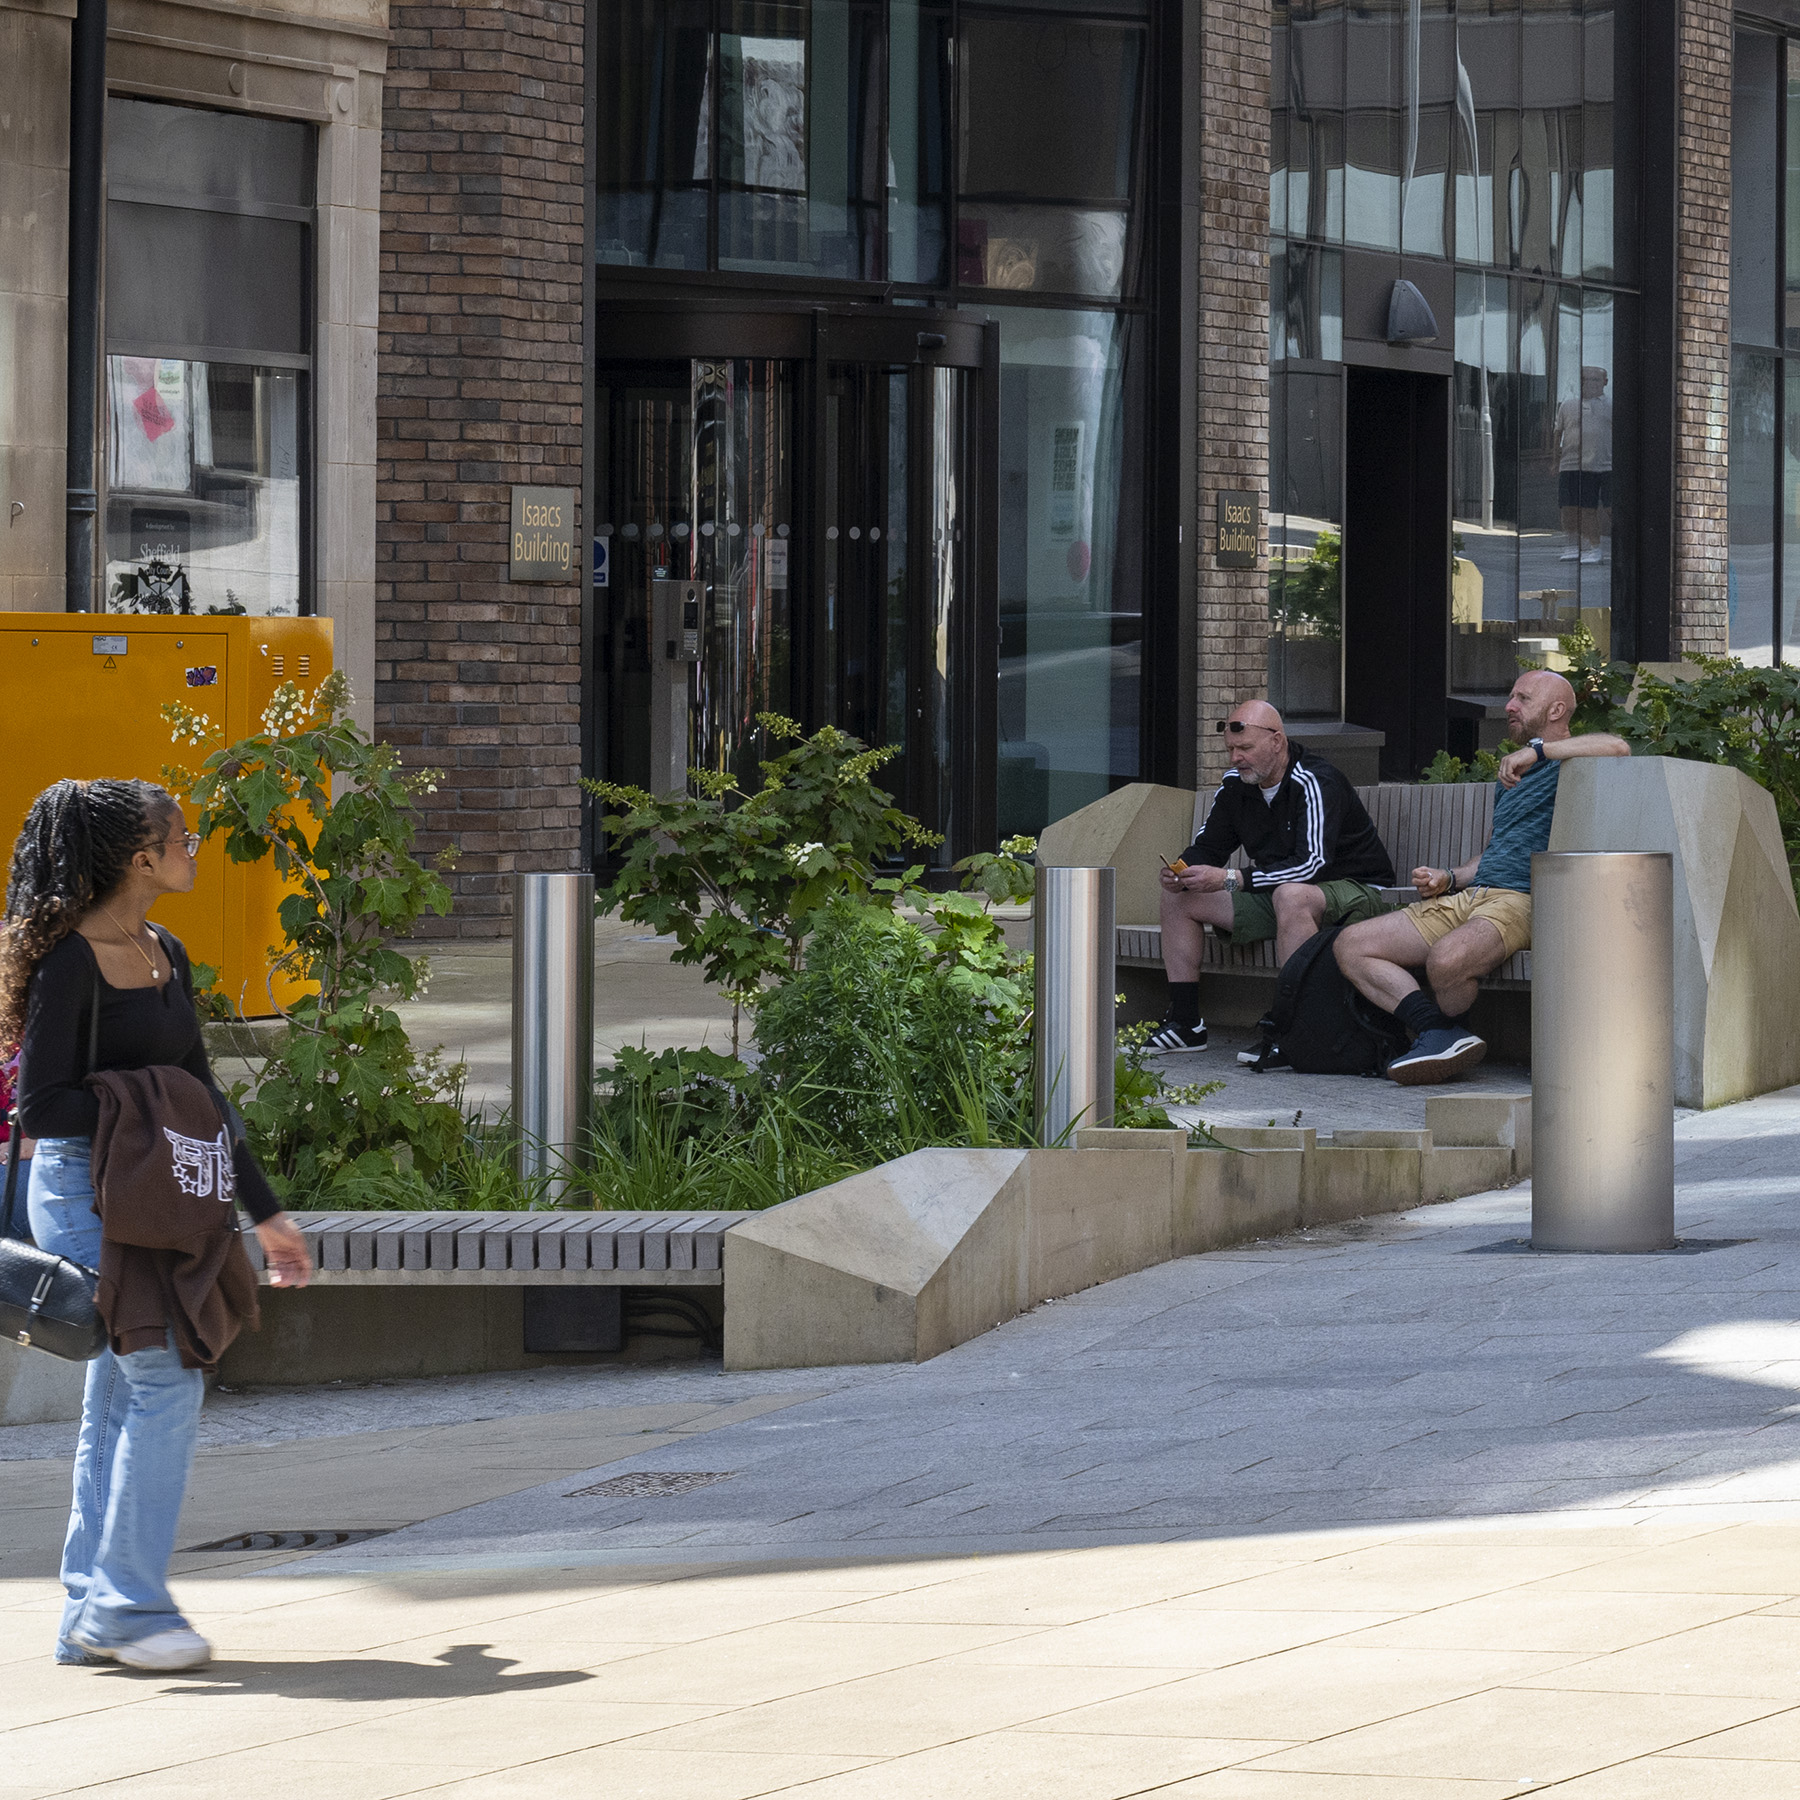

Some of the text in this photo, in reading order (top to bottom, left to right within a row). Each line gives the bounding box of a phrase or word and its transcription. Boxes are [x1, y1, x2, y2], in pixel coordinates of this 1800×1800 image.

[522, 498, 562, 528] Isaacs
[1224, 499, 1252, 524] Isaacs
[140, 543, 180, 563] Sheffield
[514, 532, 571, 570] Building
[1220, 527, 1257, 559] Building
